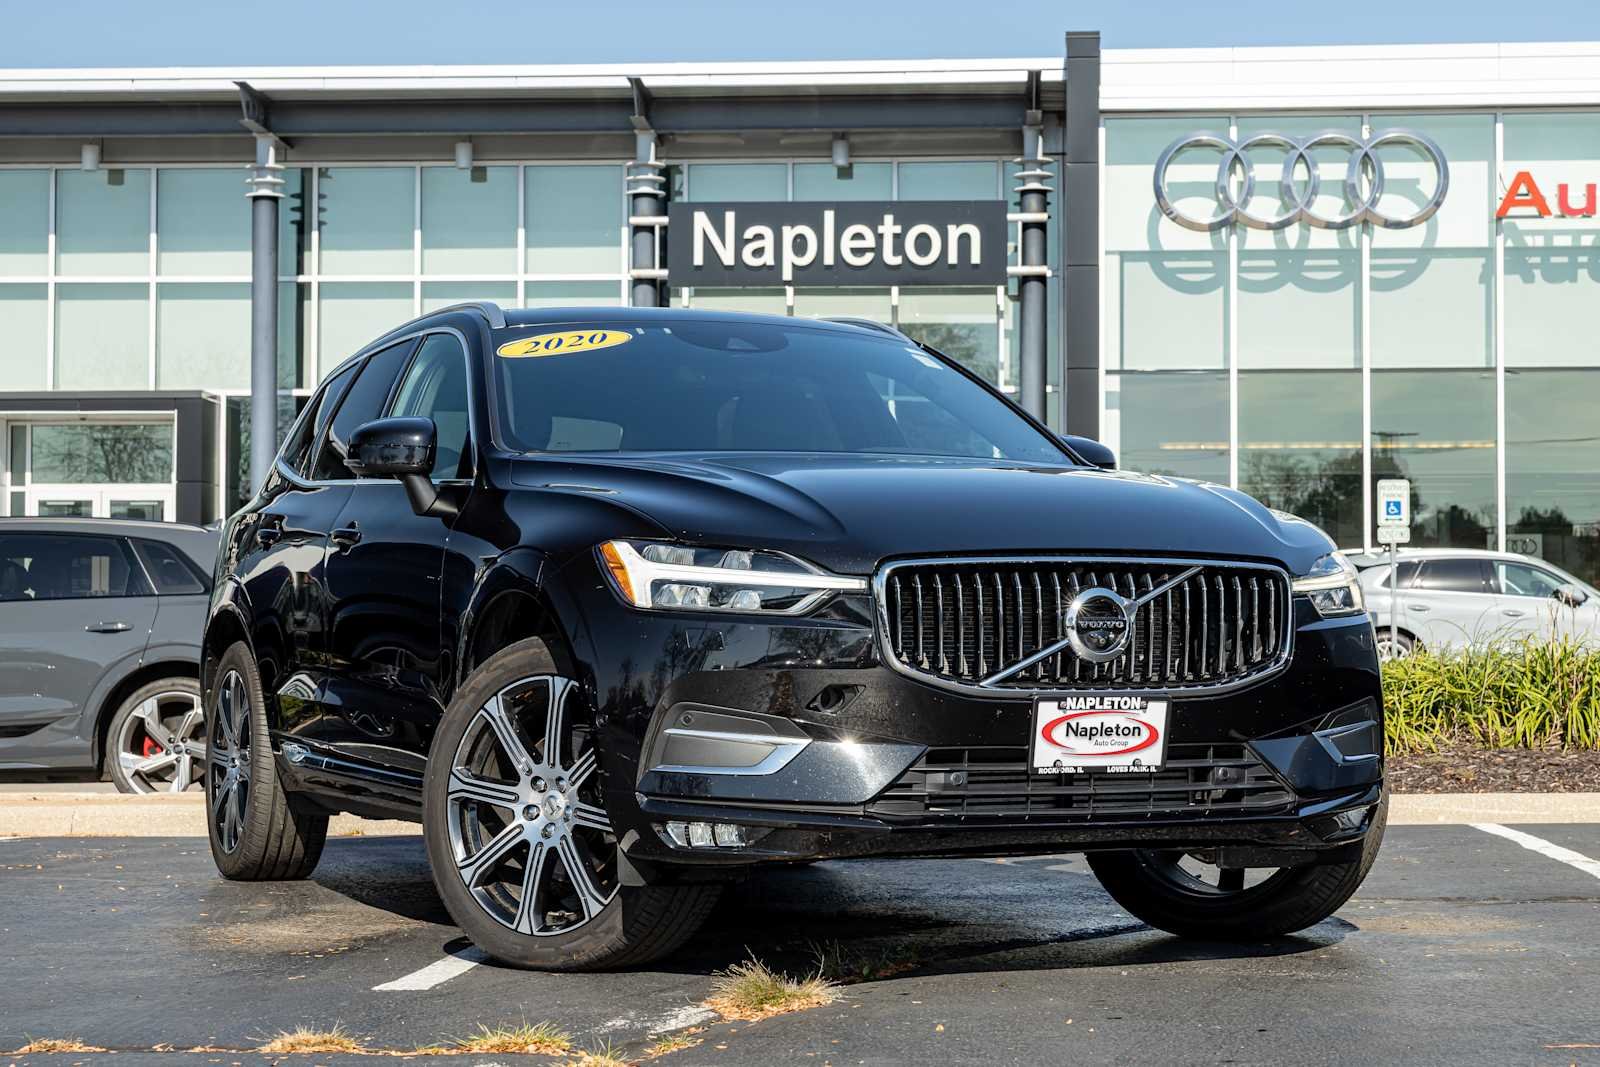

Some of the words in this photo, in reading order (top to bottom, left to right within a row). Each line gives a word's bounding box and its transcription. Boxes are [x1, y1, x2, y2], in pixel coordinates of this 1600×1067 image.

[1495, 171, 1597, 217] Au
[692, 210, 981, 281] Napleton
[523, 332, 608, 354] 2020
[1079, 620, 1125, 629] VOLVO
[1066, 697, 1142, 710] NAPLETON
[1066, 722, 1142, 740] Napleton
[1094, 739, 1109, 747] Auto
[1110, 739, 1129, 748] Group
[1150, 765, 1157, 773] IL
